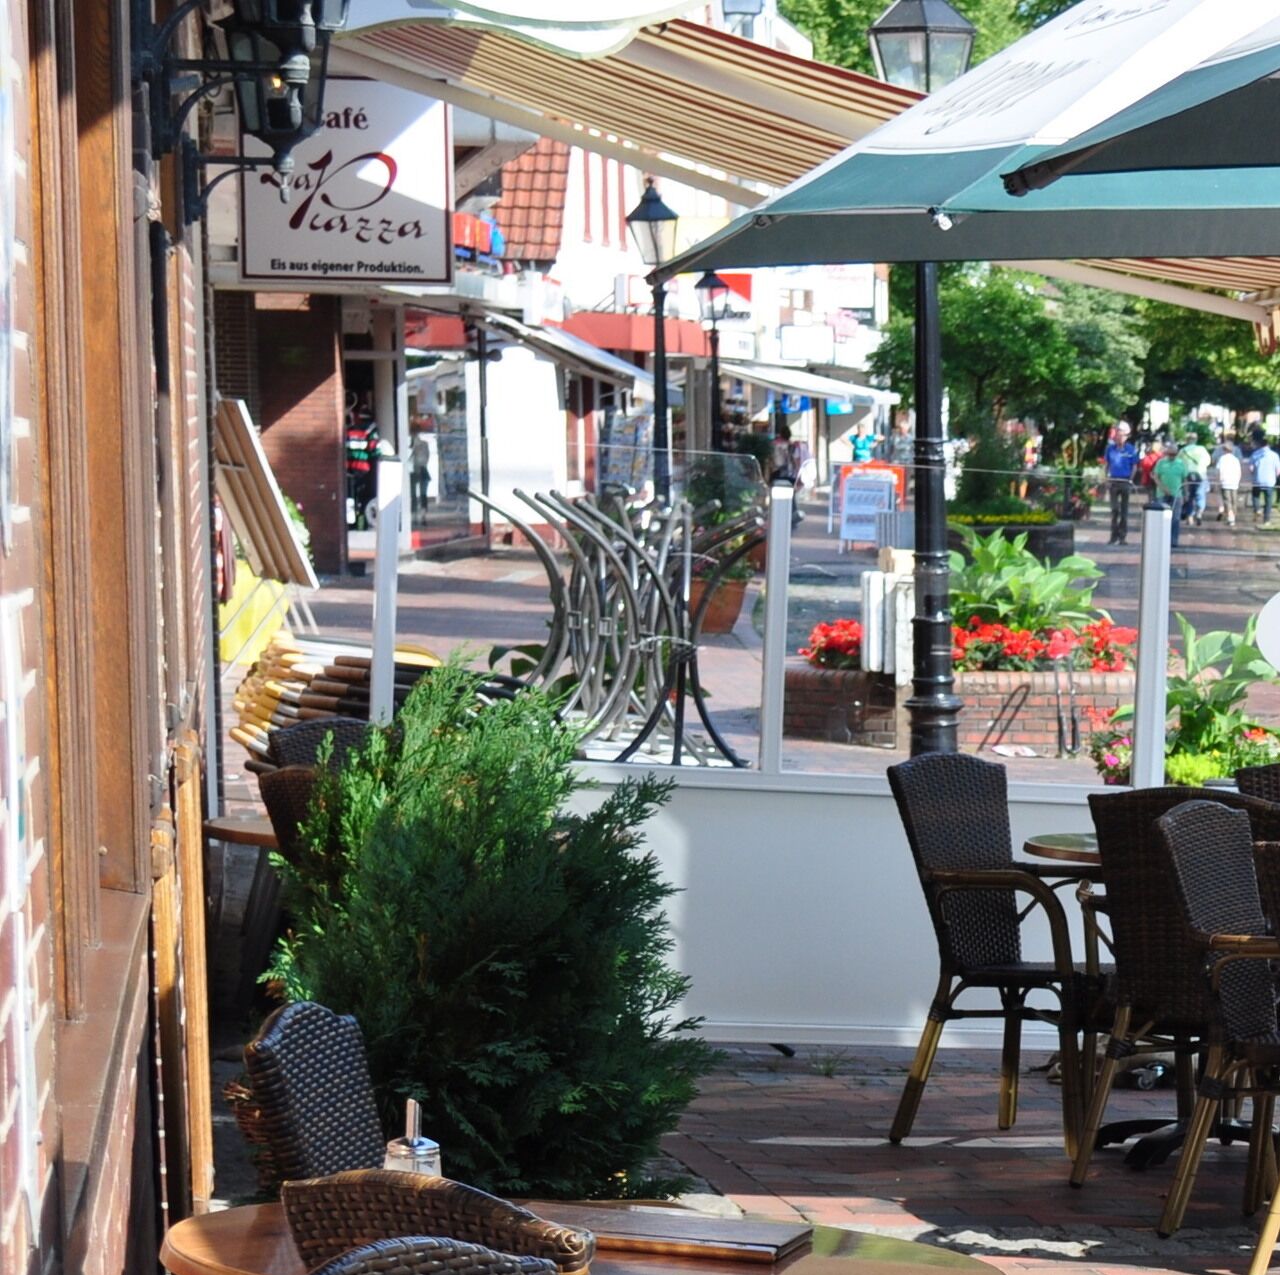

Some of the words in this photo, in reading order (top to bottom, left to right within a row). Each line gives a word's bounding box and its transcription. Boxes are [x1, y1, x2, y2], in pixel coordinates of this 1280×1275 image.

[319, 107, 369, 130] afé
[270, 258, 287, 271] Eis
[289, 261, 309, 271] aus
[311, 259, 354, 275] eigener
[356, 260, 425, 274] Produktion.
